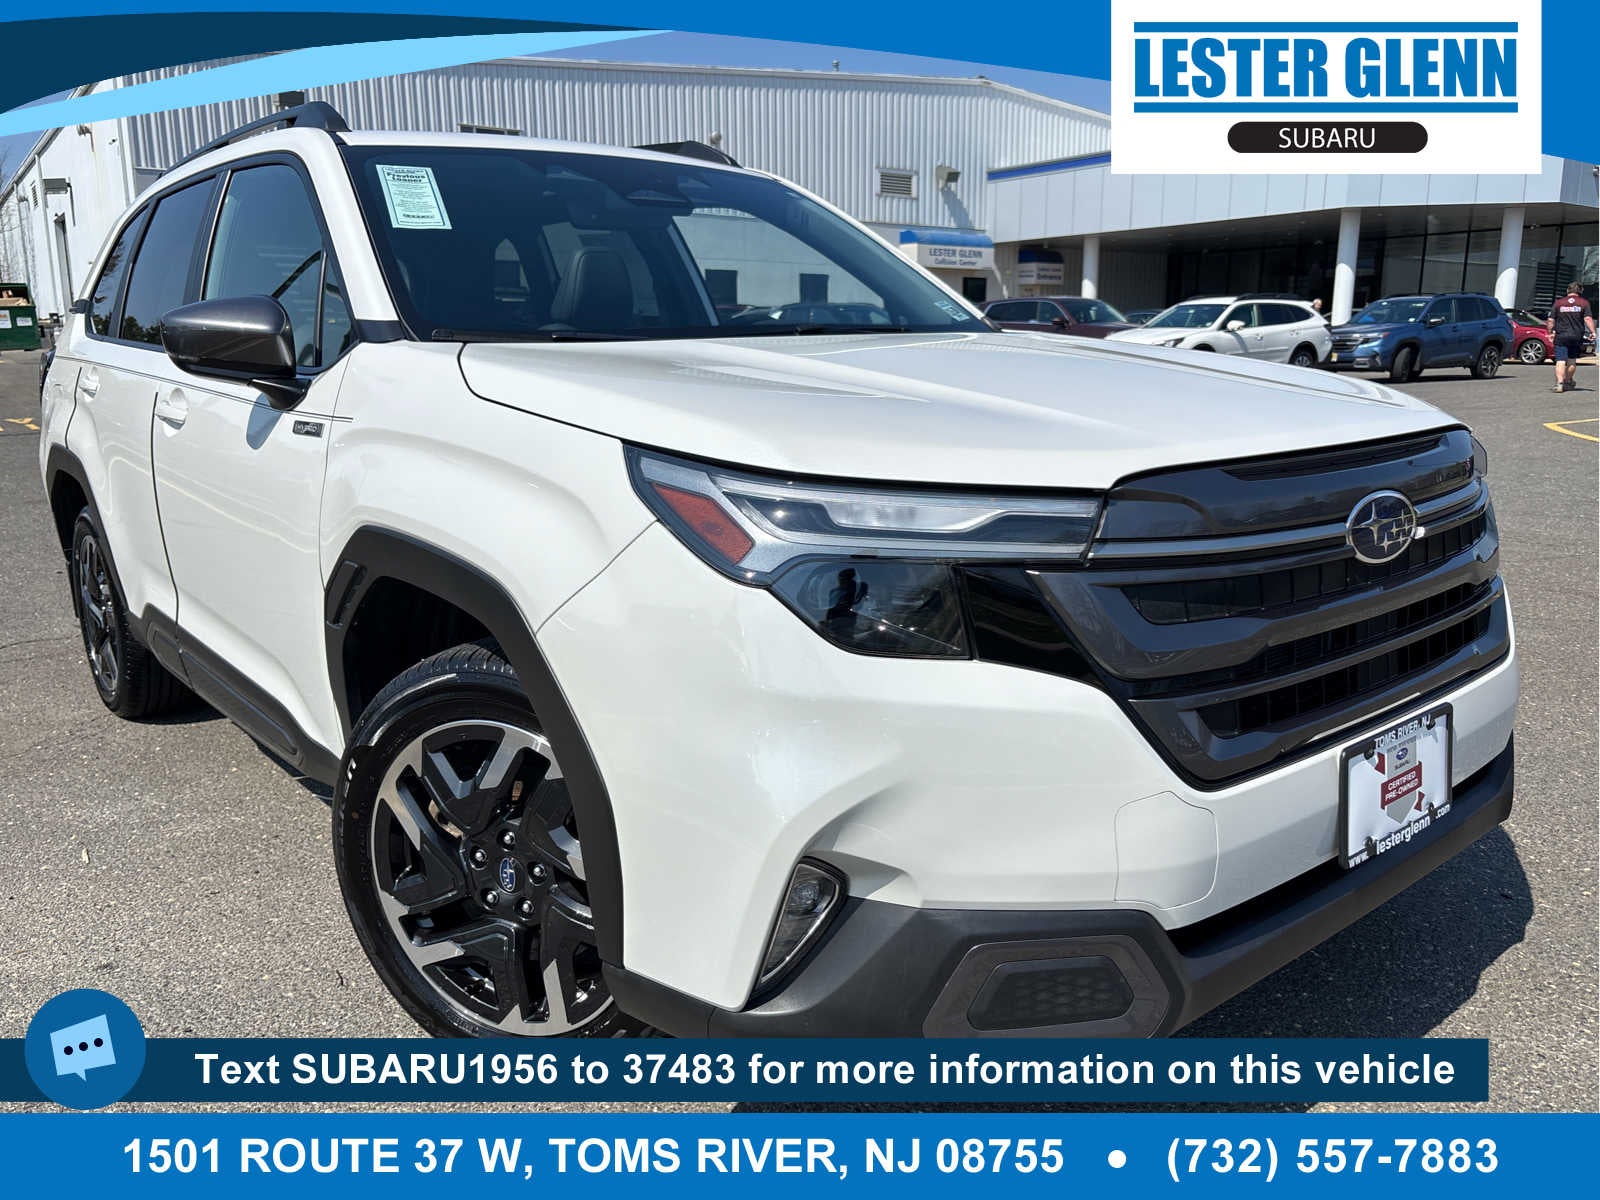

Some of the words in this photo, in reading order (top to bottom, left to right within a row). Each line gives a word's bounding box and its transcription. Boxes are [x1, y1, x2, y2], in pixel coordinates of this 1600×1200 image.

[929, 248, 957, 258] LESTER
[959, 250, 983, 259] GLENN
[1374, 730, 1396, 748] TOMS
[1421, 714, 1431, 727] NJ
[1385, 778, 1419, 801] PRE-OWNED
[1387, 770, 1417, 791] CERTIFIED
[1376, 815, 1432, 856] lesterglenn
